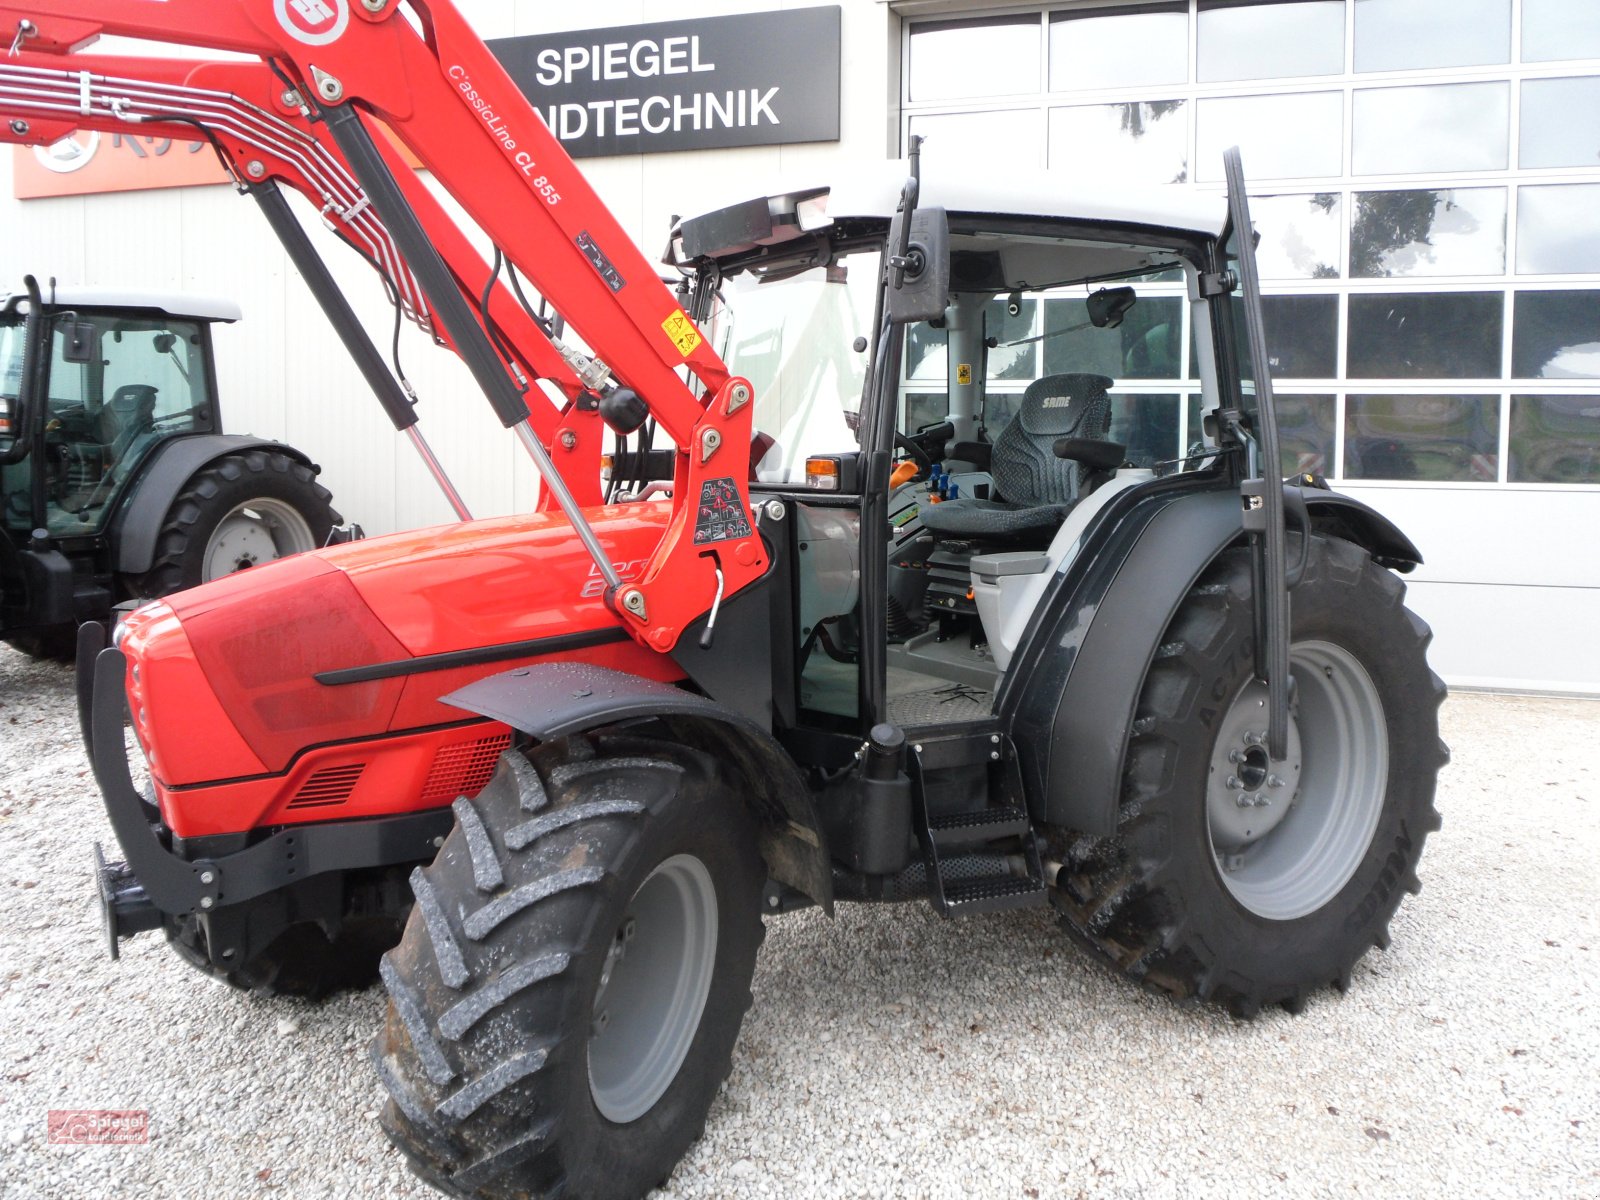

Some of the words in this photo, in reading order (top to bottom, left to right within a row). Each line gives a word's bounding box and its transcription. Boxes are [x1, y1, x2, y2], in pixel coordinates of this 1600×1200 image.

[536, 35, 715, 86] SPIEGEL
[448, 65, 516, 150] CassicLine
[515, 151, 536, 177] CL
[533, 175, 562, 205] 855
